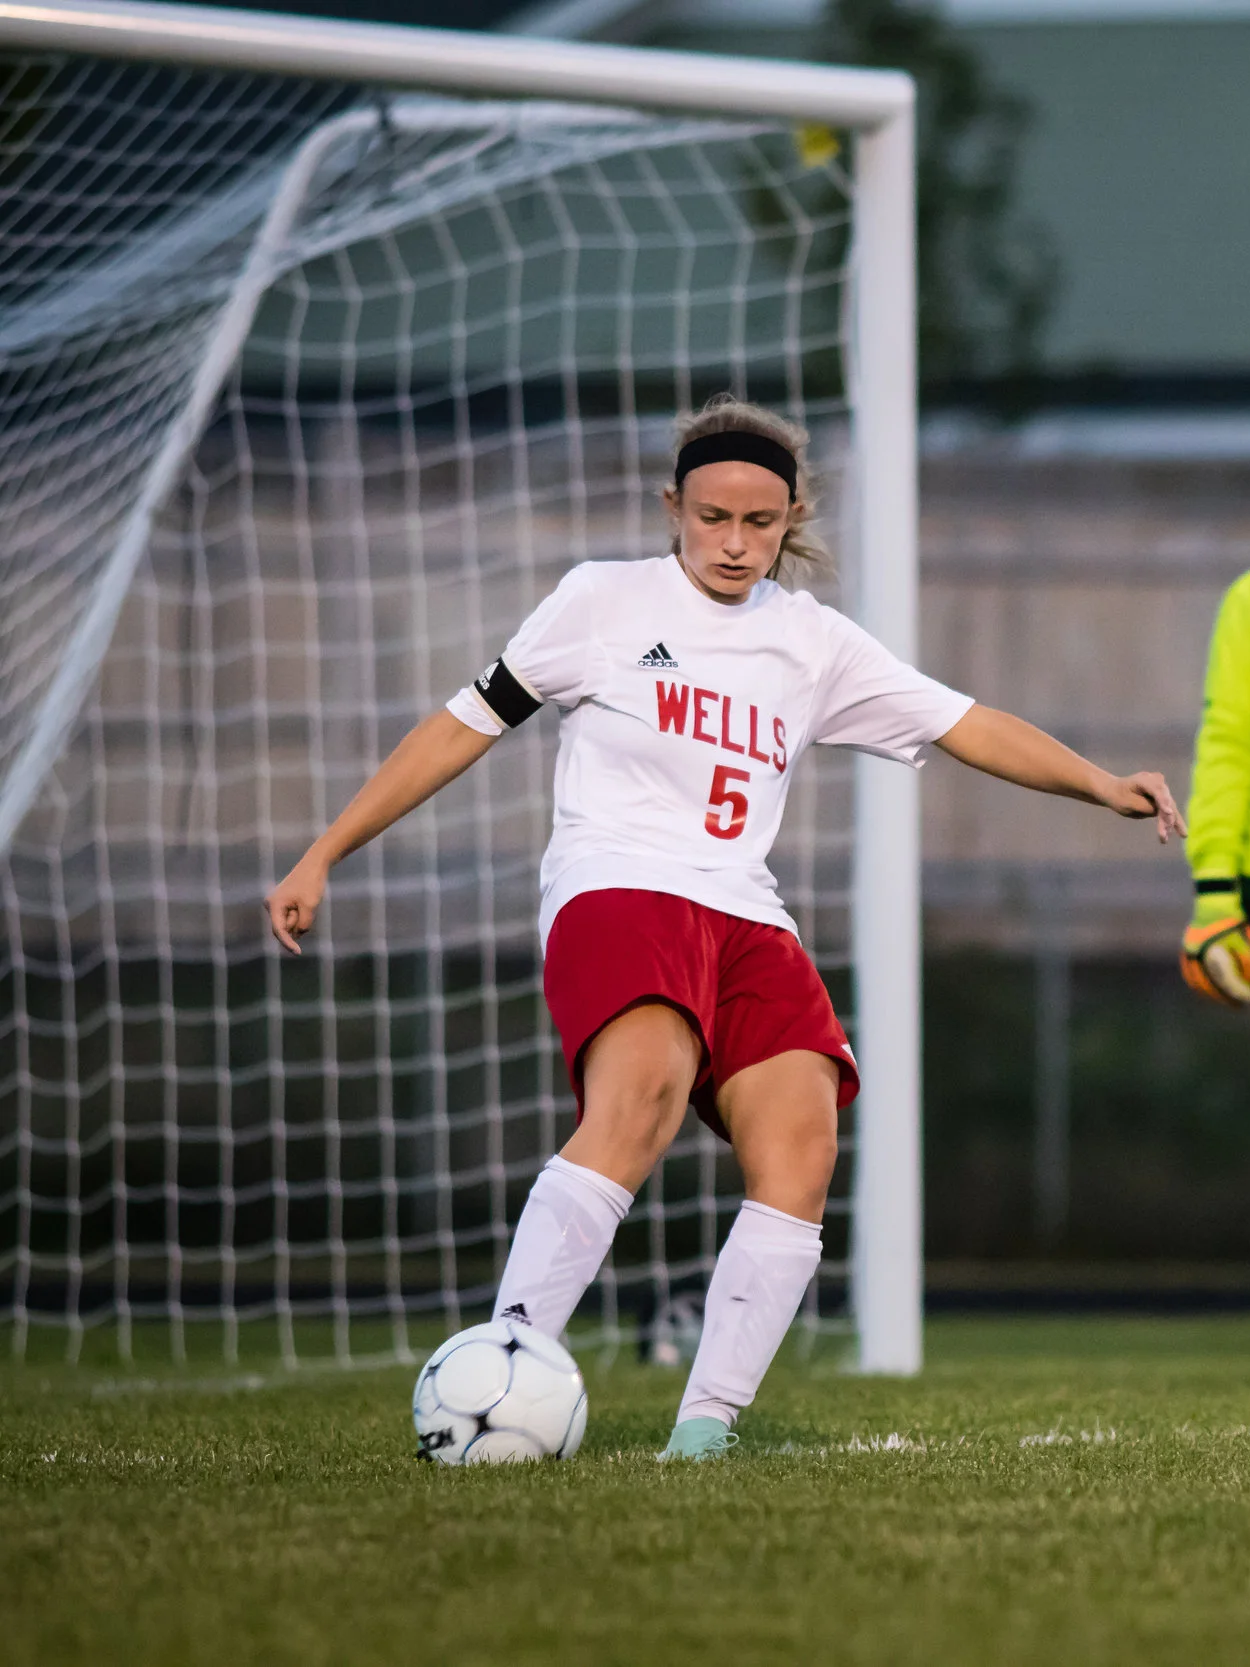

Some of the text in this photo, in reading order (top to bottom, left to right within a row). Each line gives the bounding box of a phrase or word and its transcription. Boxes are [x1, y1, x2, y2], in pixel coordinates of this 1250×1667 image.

[637, 658, 679, 669] adidas
[656, 680, 788, 775] WELLS
[704, 764, 751, 841] 5
